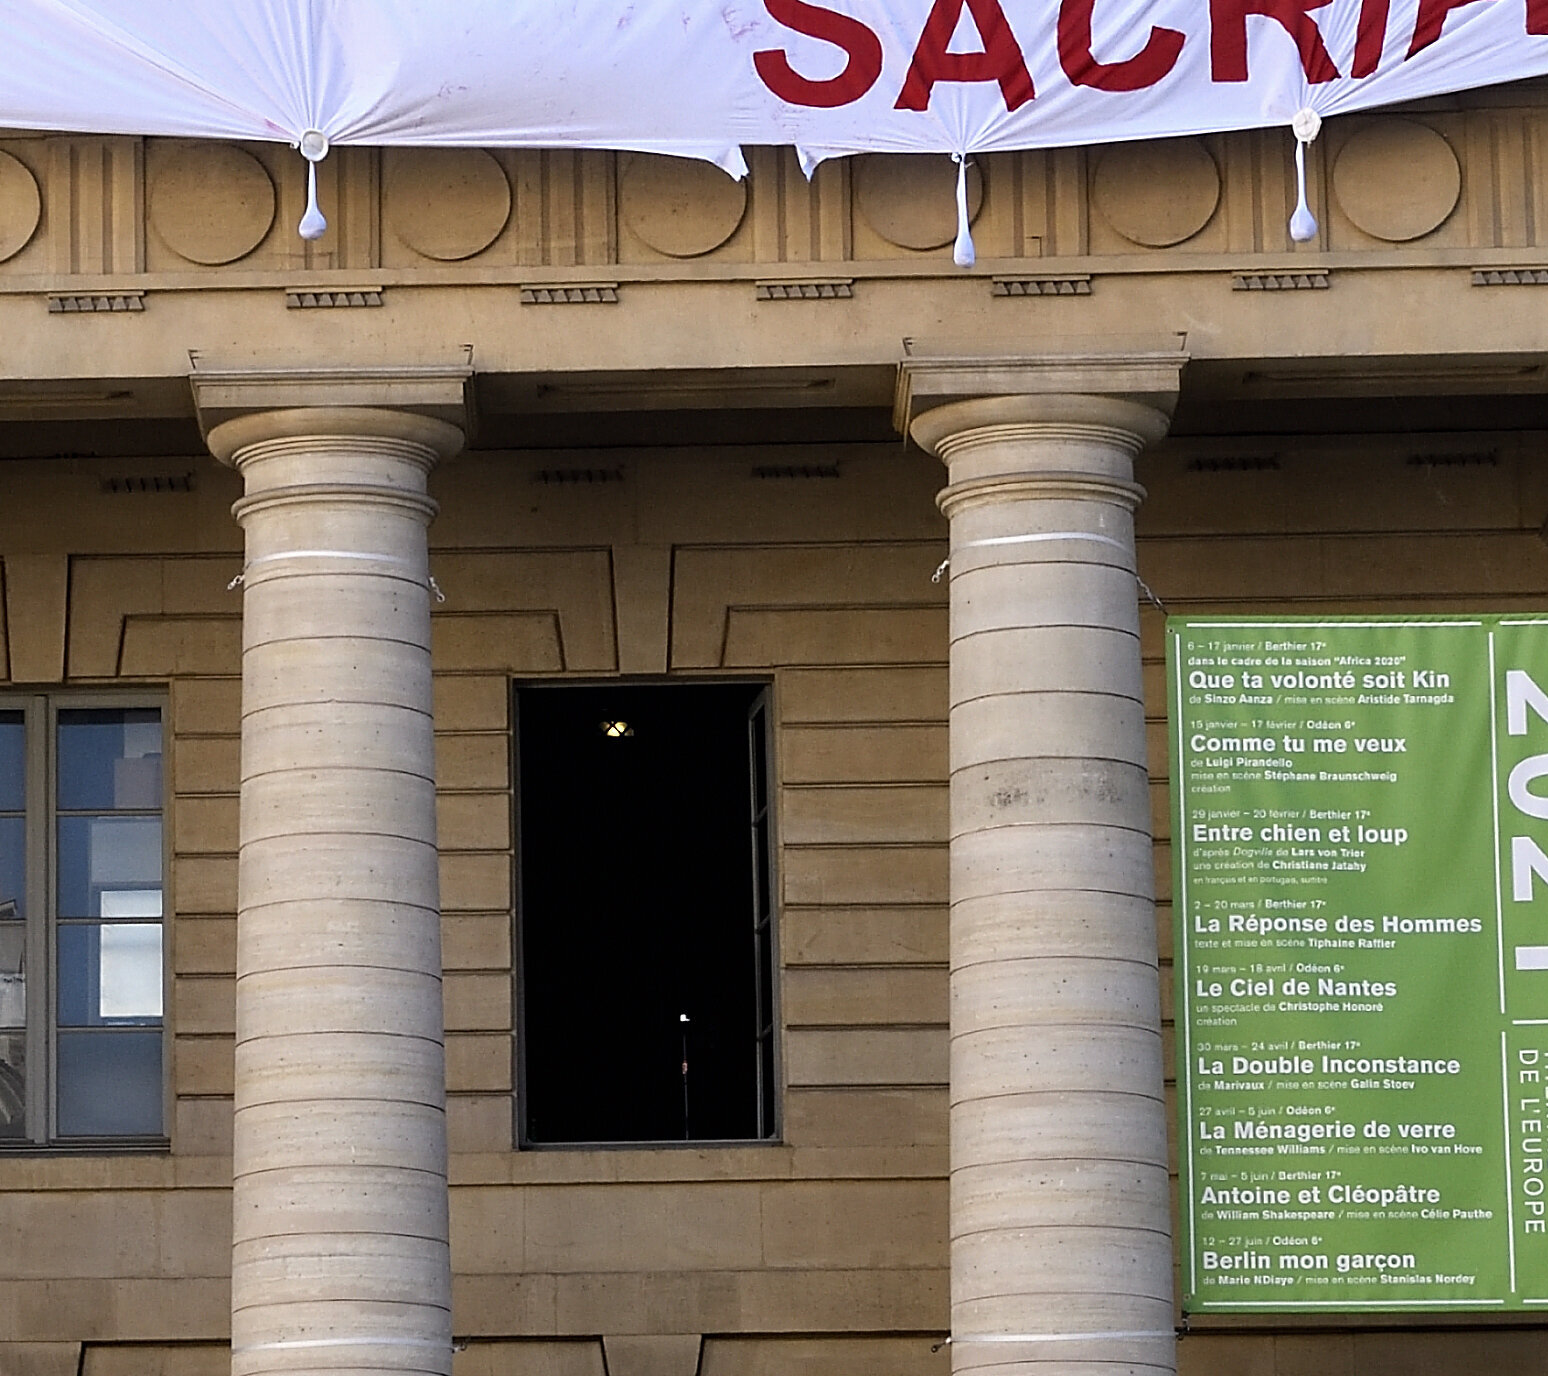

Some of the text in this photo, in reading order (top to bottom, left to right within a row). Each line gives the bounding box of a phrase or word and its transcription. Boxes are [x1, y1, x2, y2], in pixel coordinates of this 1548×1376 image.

[1189, 670, 1450, 689] Que ta volonté soit Kin
[1191, 734, 1407, 752] Comme tu me veux
[1193, 824, 1408, 845] Entre chien et loup
[1194, 914, 1482, 935] La Réponse des Hommes
[1196, 978, 1397, 997] Le Ciel de Nantes
[1198, 1055, 1461, 1075] La Double Inconstance
[1200, 1120, 1456, 1142] La Ménagerie de verre
[1518, 1049, 1546, 1235] DE L'EUROPE
[1201, 1185, 1440, 1207] Antoine et Cléopâtre
[1204, 1251, 1415, 1272] Berlin mon garçon
